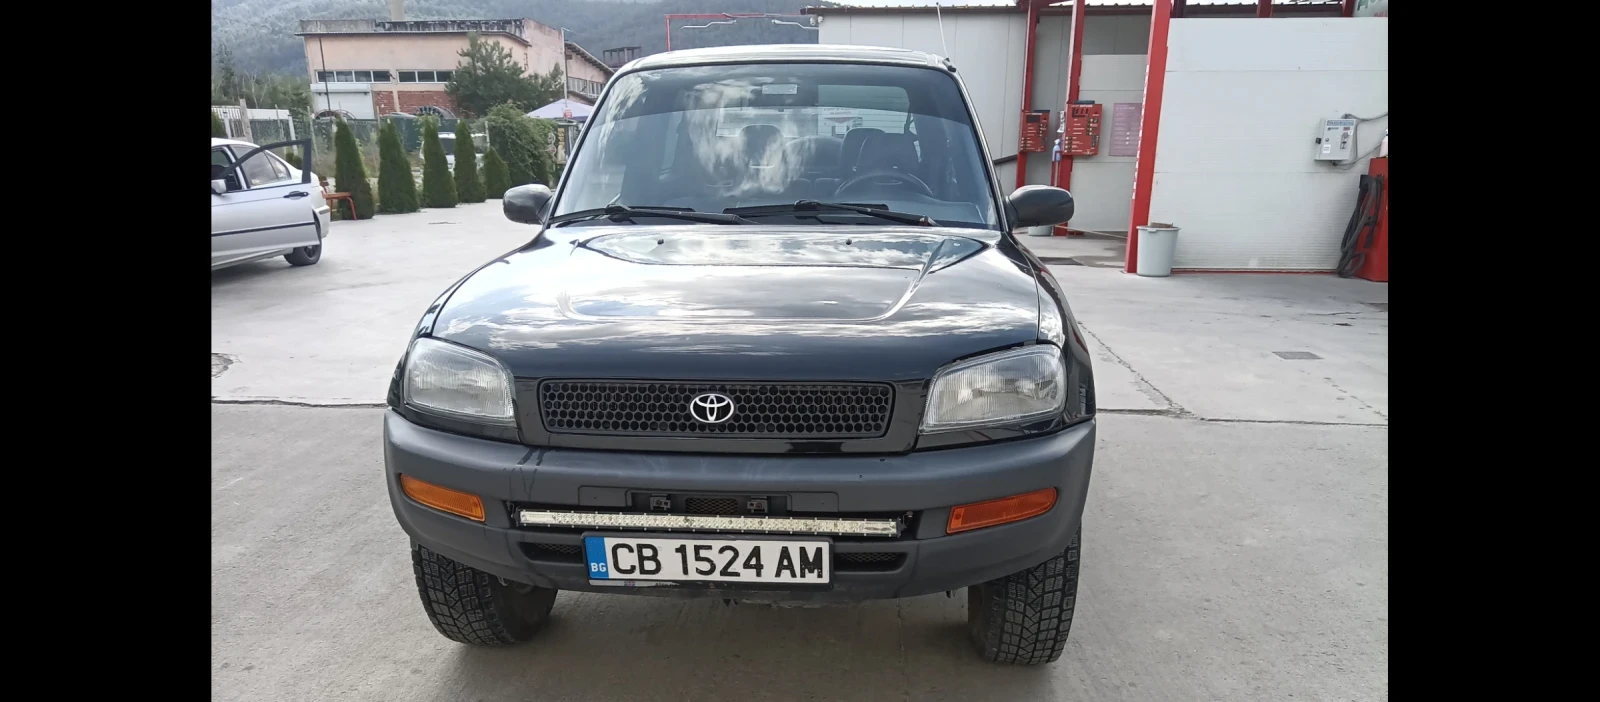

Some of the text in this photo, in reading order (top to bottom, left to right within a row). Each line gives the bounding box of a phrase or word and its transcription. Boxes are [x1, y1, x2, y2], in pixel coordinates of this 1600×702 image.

[591, 562, 606, 572] BG
[611, 543, 823, 579] CB 1524 AM
